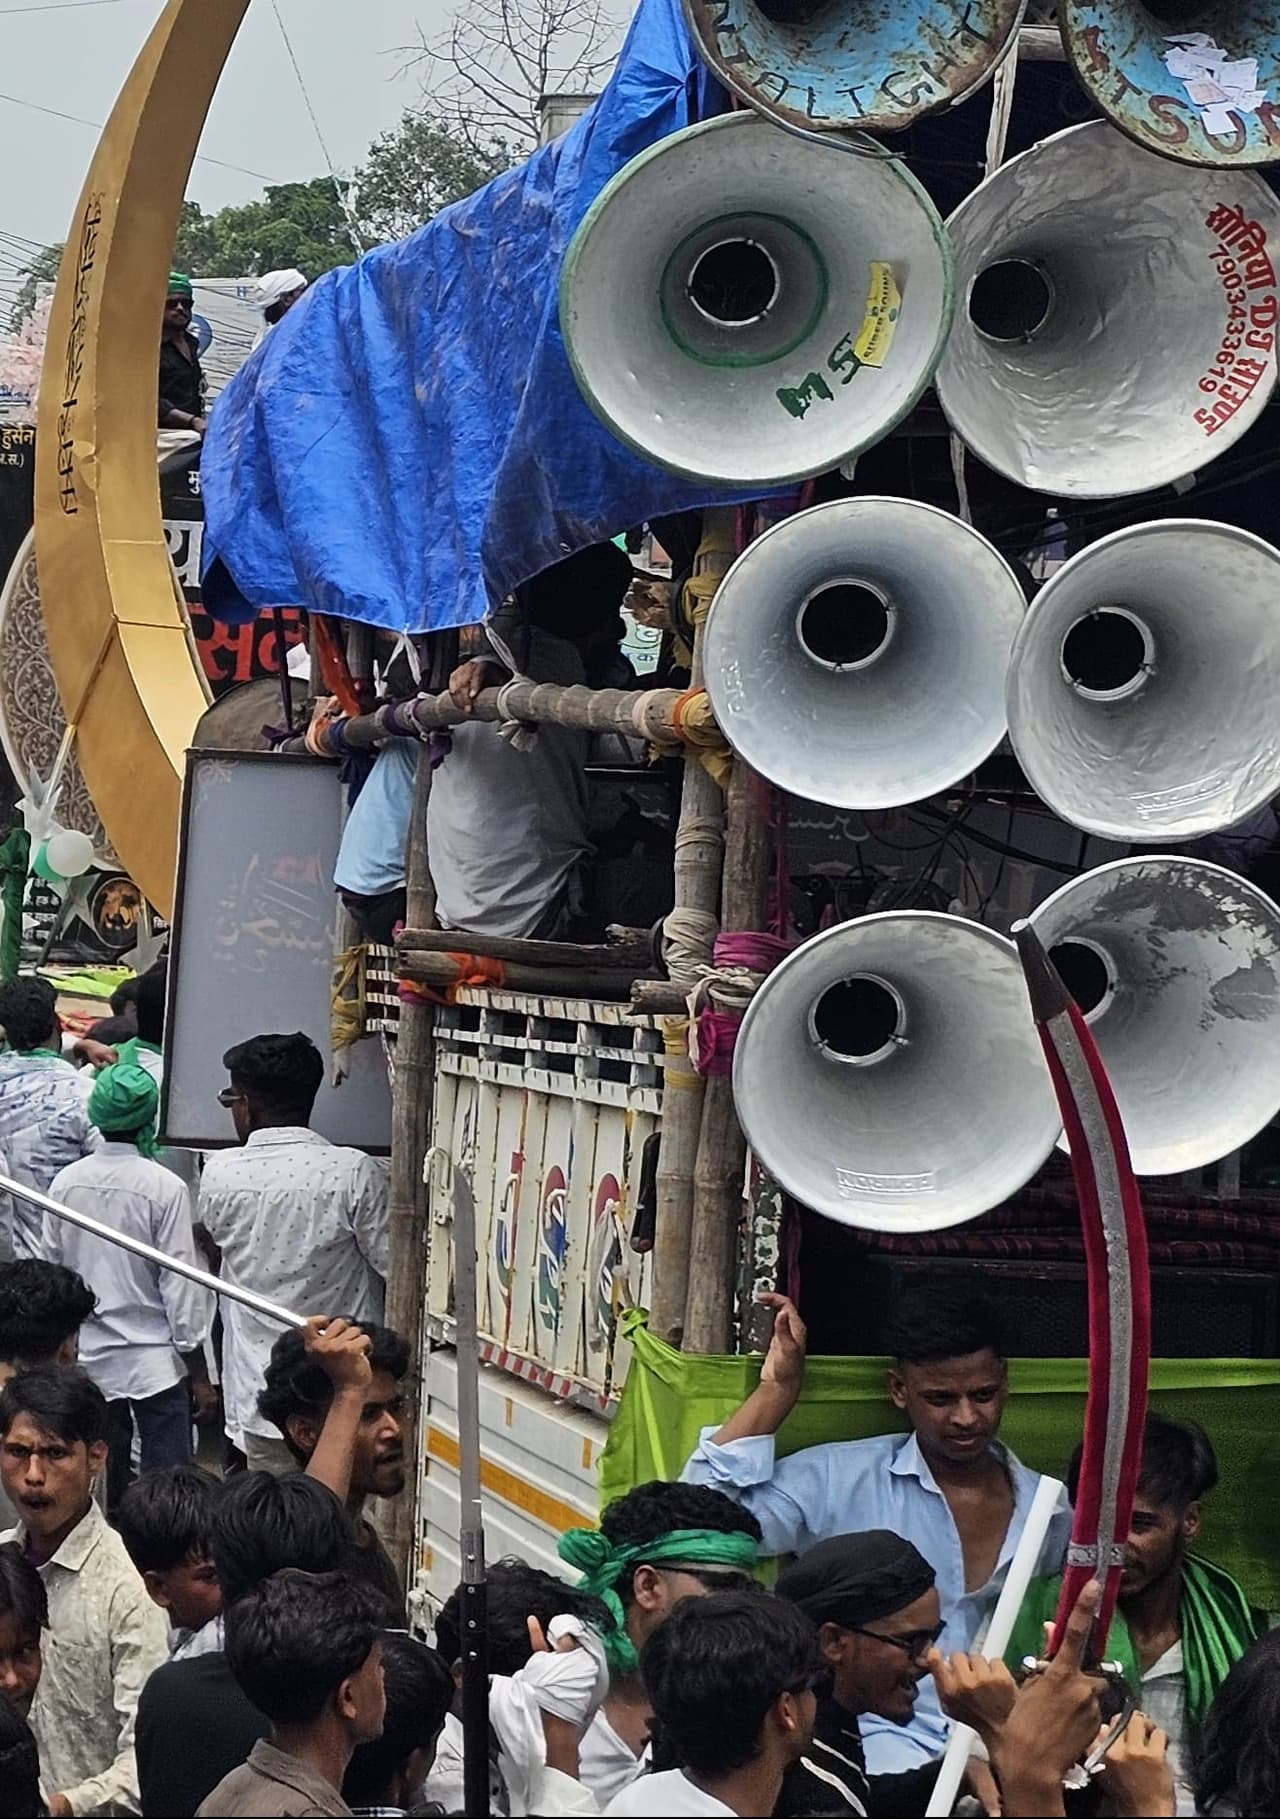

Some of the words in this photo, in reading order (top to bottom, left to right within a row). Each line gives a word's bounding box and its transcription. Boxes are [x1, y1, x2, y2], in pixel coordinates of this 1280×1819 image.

[1198, 243, 1248, 394] 7903433619
[1205, 202, 1278, 291] सोनिया
[1245, 295, 1278, 352] DJ
